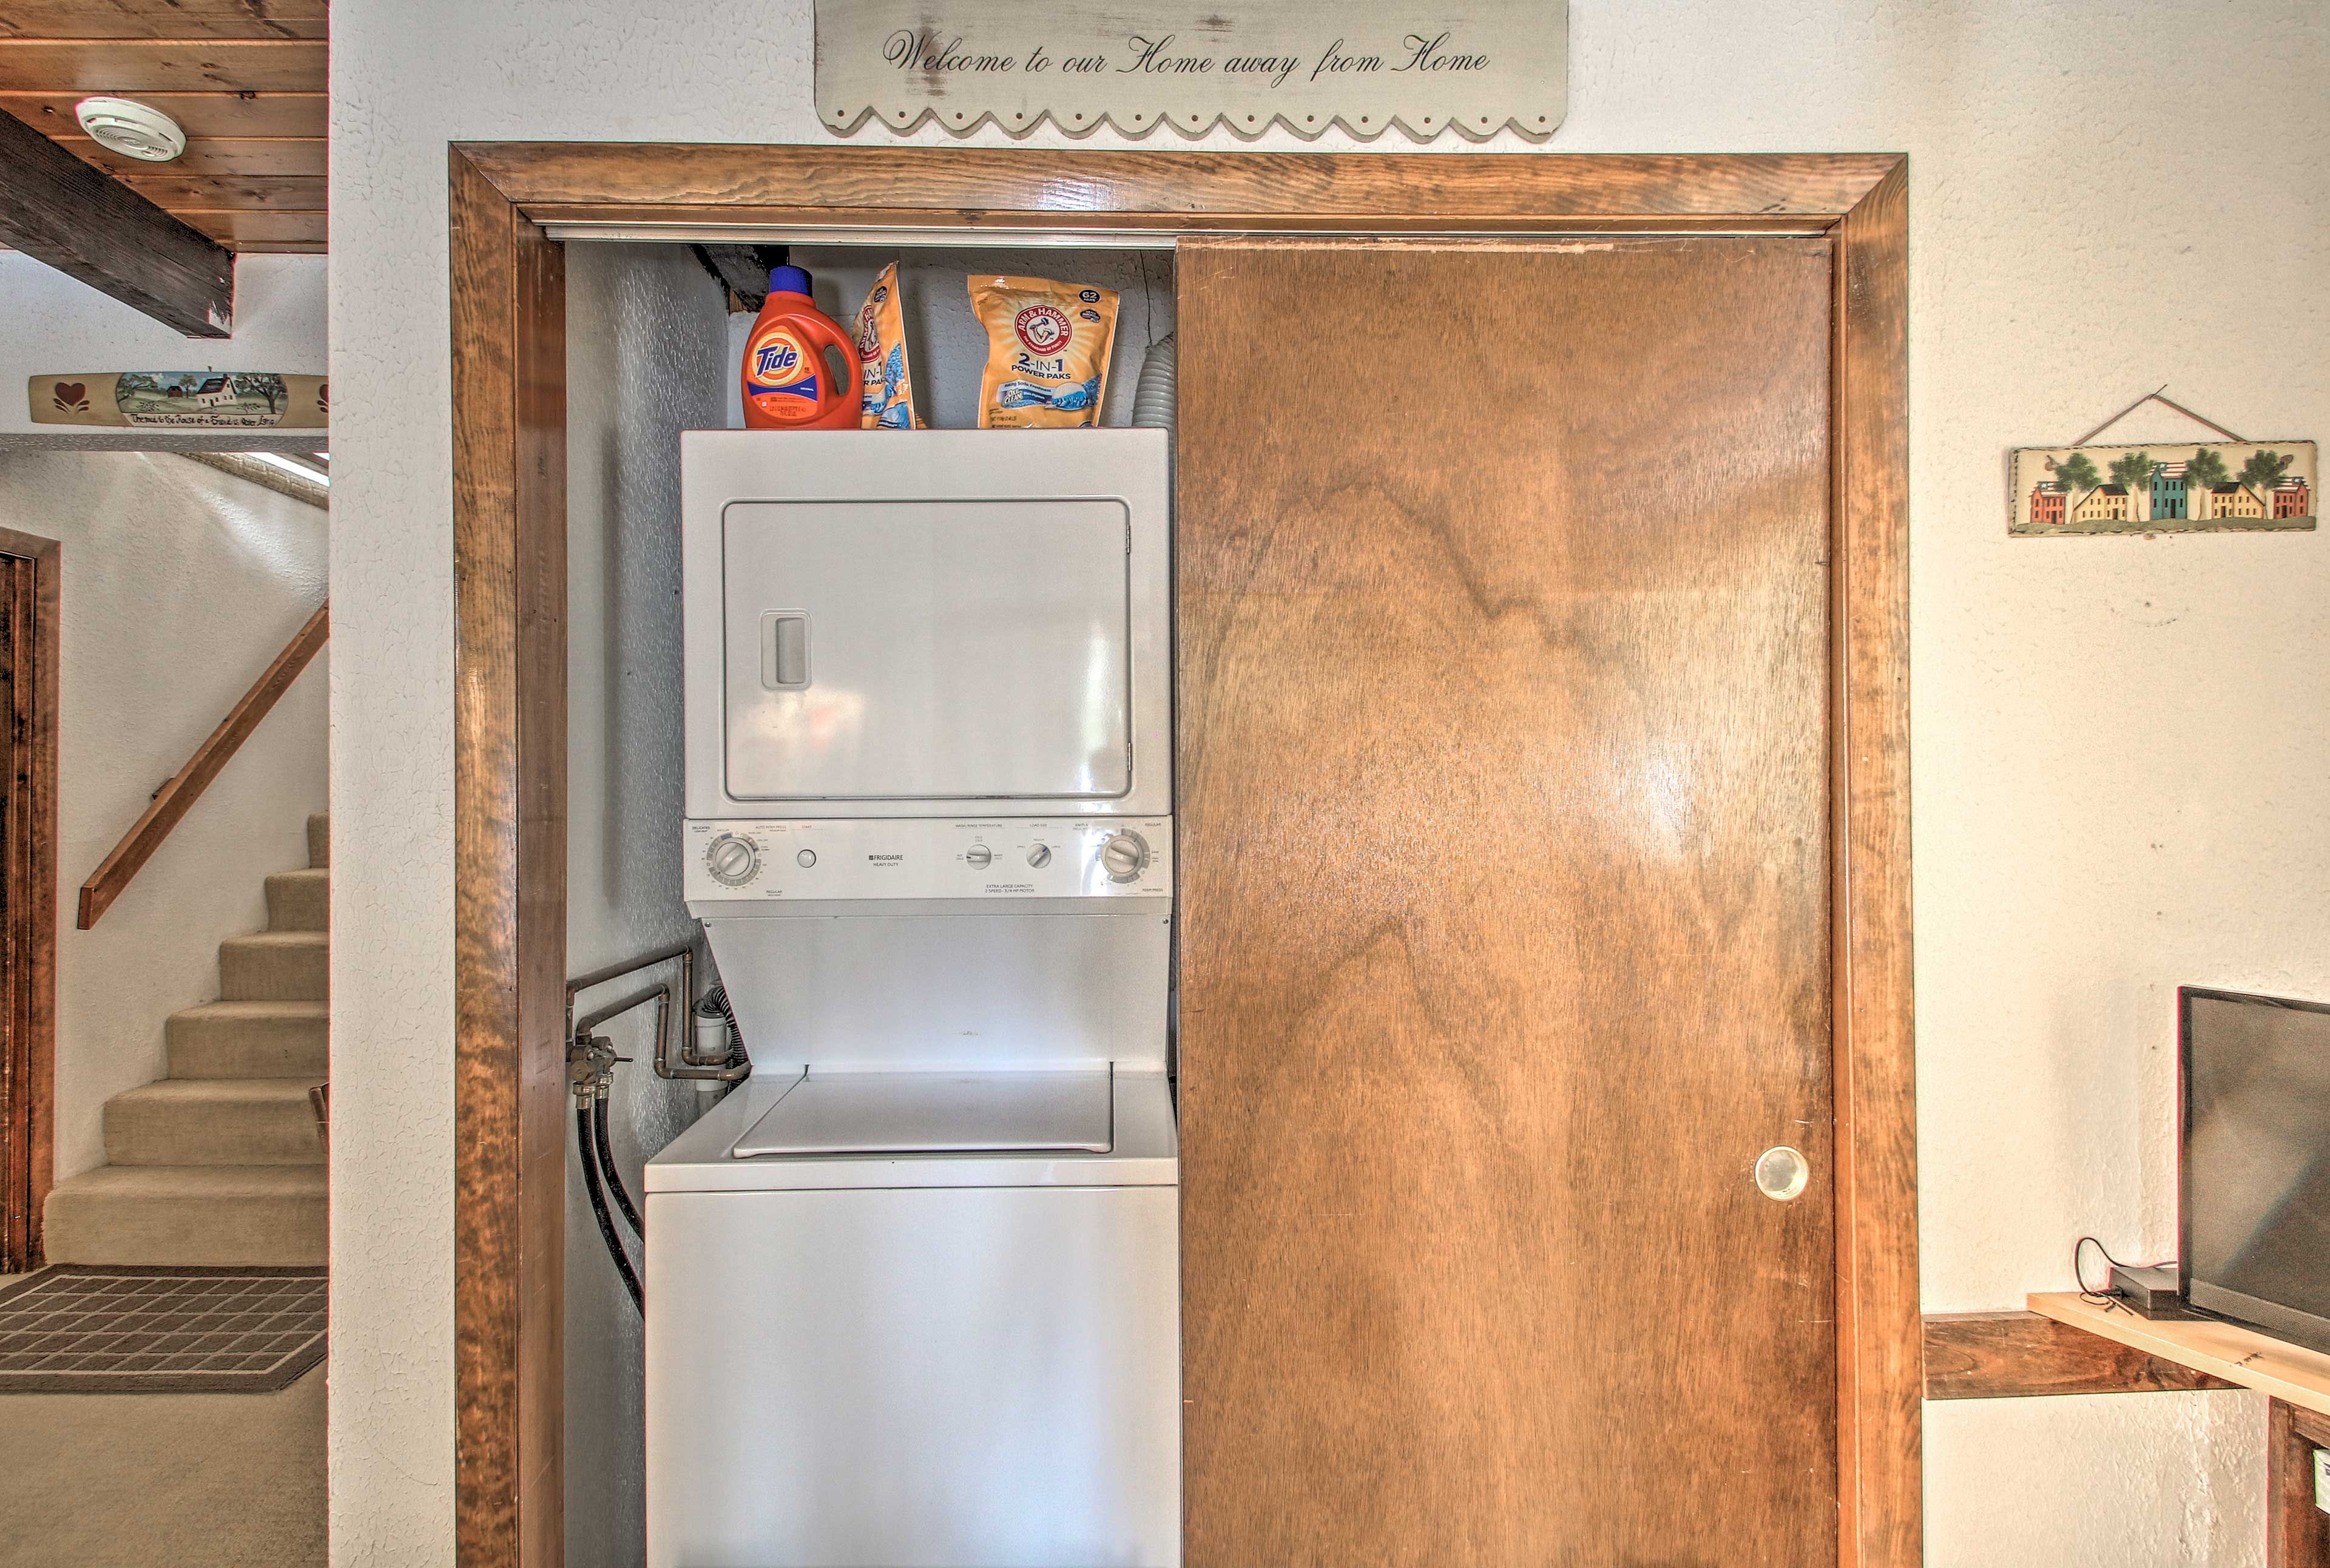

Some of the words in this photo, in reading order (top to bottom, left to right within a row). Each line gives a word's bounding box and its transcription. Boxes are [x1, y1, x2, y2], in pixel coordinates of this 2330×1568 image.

[883, 29, 1017, 72] Welcome
[1024, 46, 1052, 72] to
[1062, 53, 1109, 72] our
[1115, 35, 1215, 73] Home
[1223, 53, 1300, 88] away
[1309, 39, 1385, 82] from
[1390, 32, 1490, 72] Home
[1018, 313, 1030, 331] ARM
[1038, 308, 1069, 336] HAMMER
[756, 345, 799, 378] Tide
[1011, 365, 1045, 378] POWER
[1019, 353, 1063, 372] 2-IN-1
